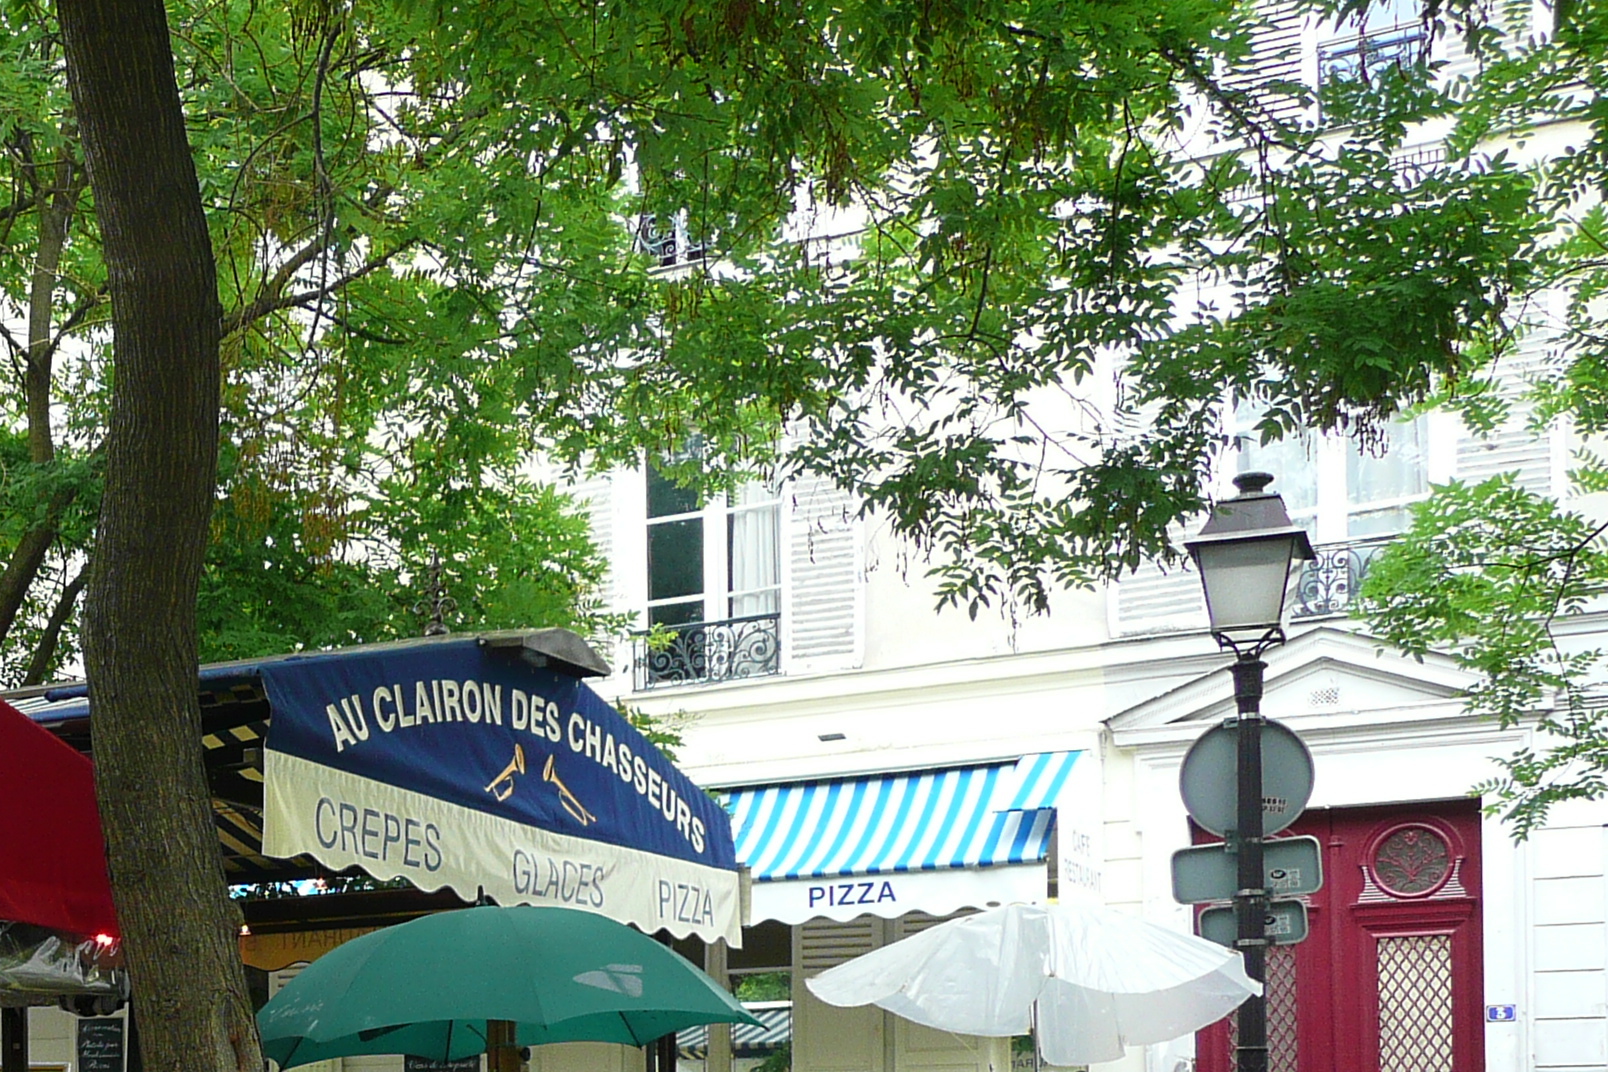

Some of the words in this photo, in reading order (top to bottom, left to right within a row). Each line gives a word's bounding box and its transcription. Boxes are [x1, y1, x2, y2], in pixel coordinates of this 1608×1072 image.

[326, 694, 369, 753] AU
[373, 679, 502, 733] CLAIRON
[511, 688, 562, 743] DES
[567, 711, 706, 854] CHASSEURS
[315, 797, 442, 872] CREPES
[513, 849, 605, 908] GLACES
[658, 879, 714, 927] PIZZA
[809, 881, 897, 908] PIZZA
